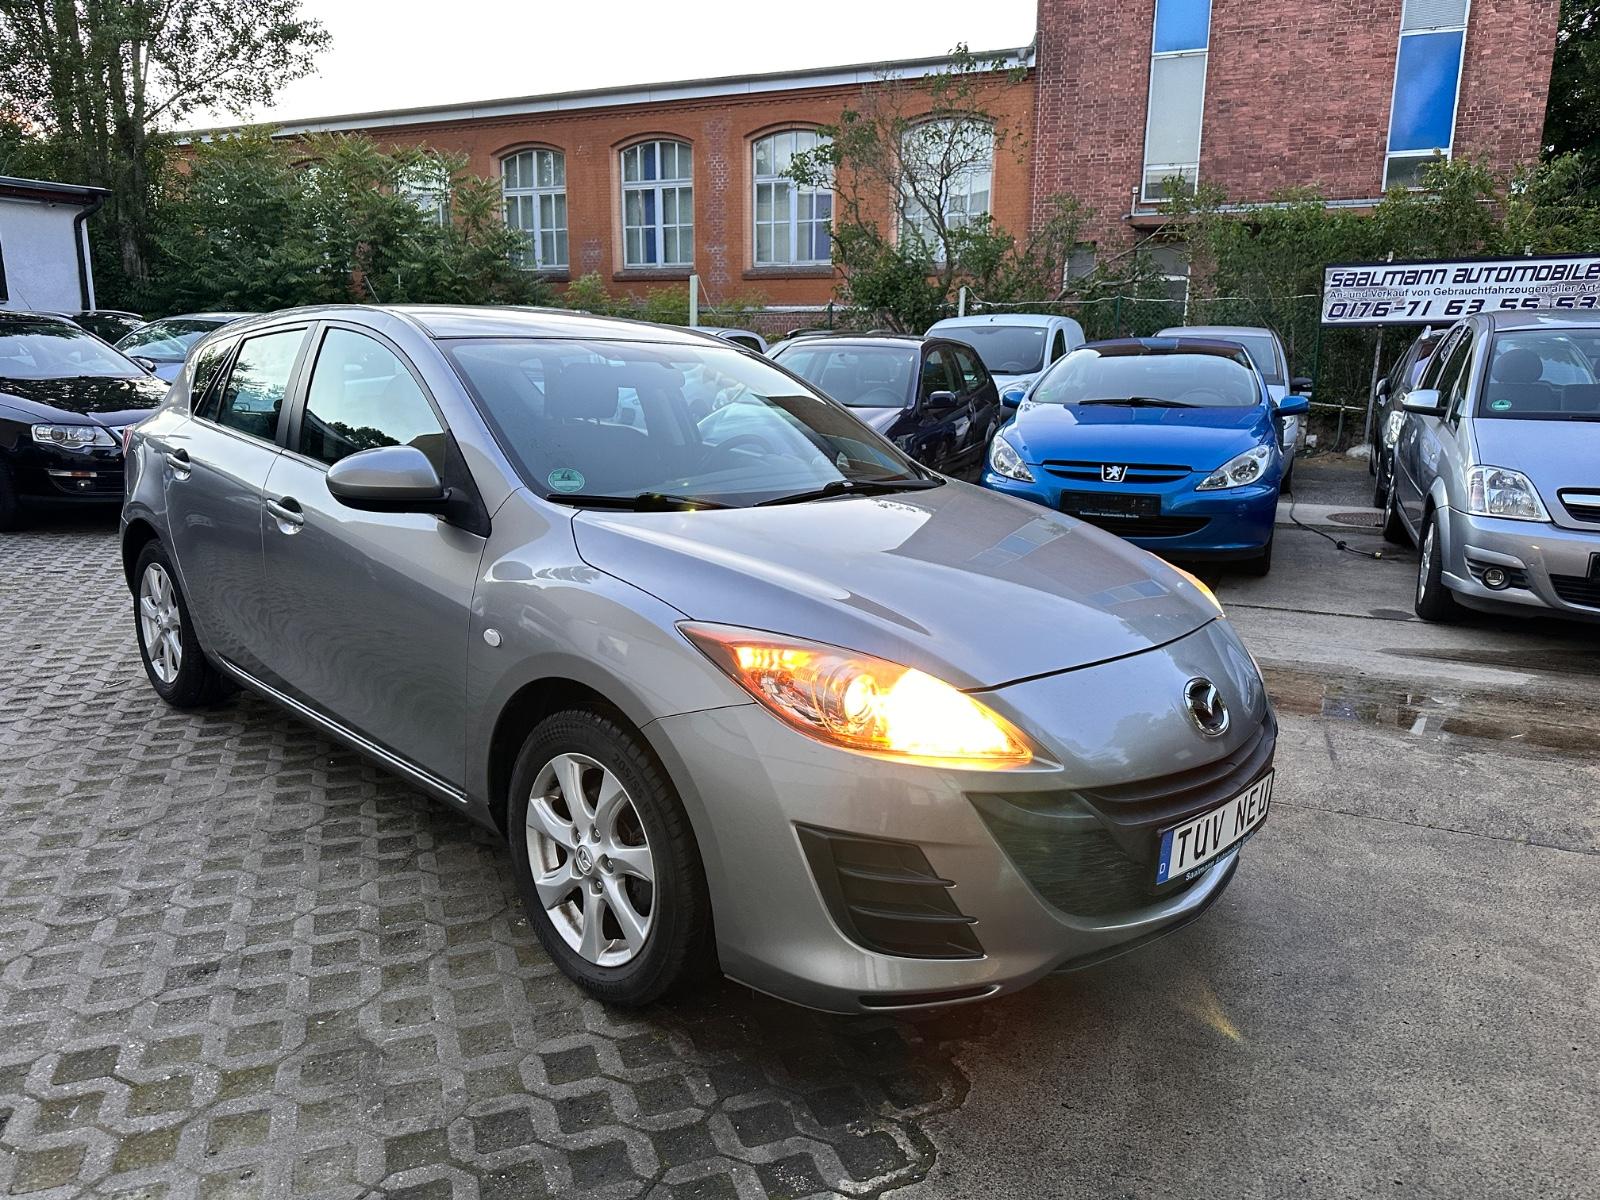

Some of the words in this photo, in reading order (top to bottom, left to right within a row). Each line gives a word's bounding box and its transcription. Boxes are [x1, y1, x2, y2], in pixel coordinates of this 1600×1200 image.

[1349, 290, 1368, 298] und
[1371, 288, 1409, 297] Verkauf
[1411, 288, 1430, 297] von
[1433, 284, 1548, 296] Gebrauchtfahrzeugen
[1551, 283, 1575, 293] aller
[1327, 300, 1432, 318] 0176-71
[1444, 299, 1485, 316] 63
[1177, 810, 1225, 868] TÜV
[1234, 778, 1270, 836] NEU
[1159, 862, 1166, 875] D
